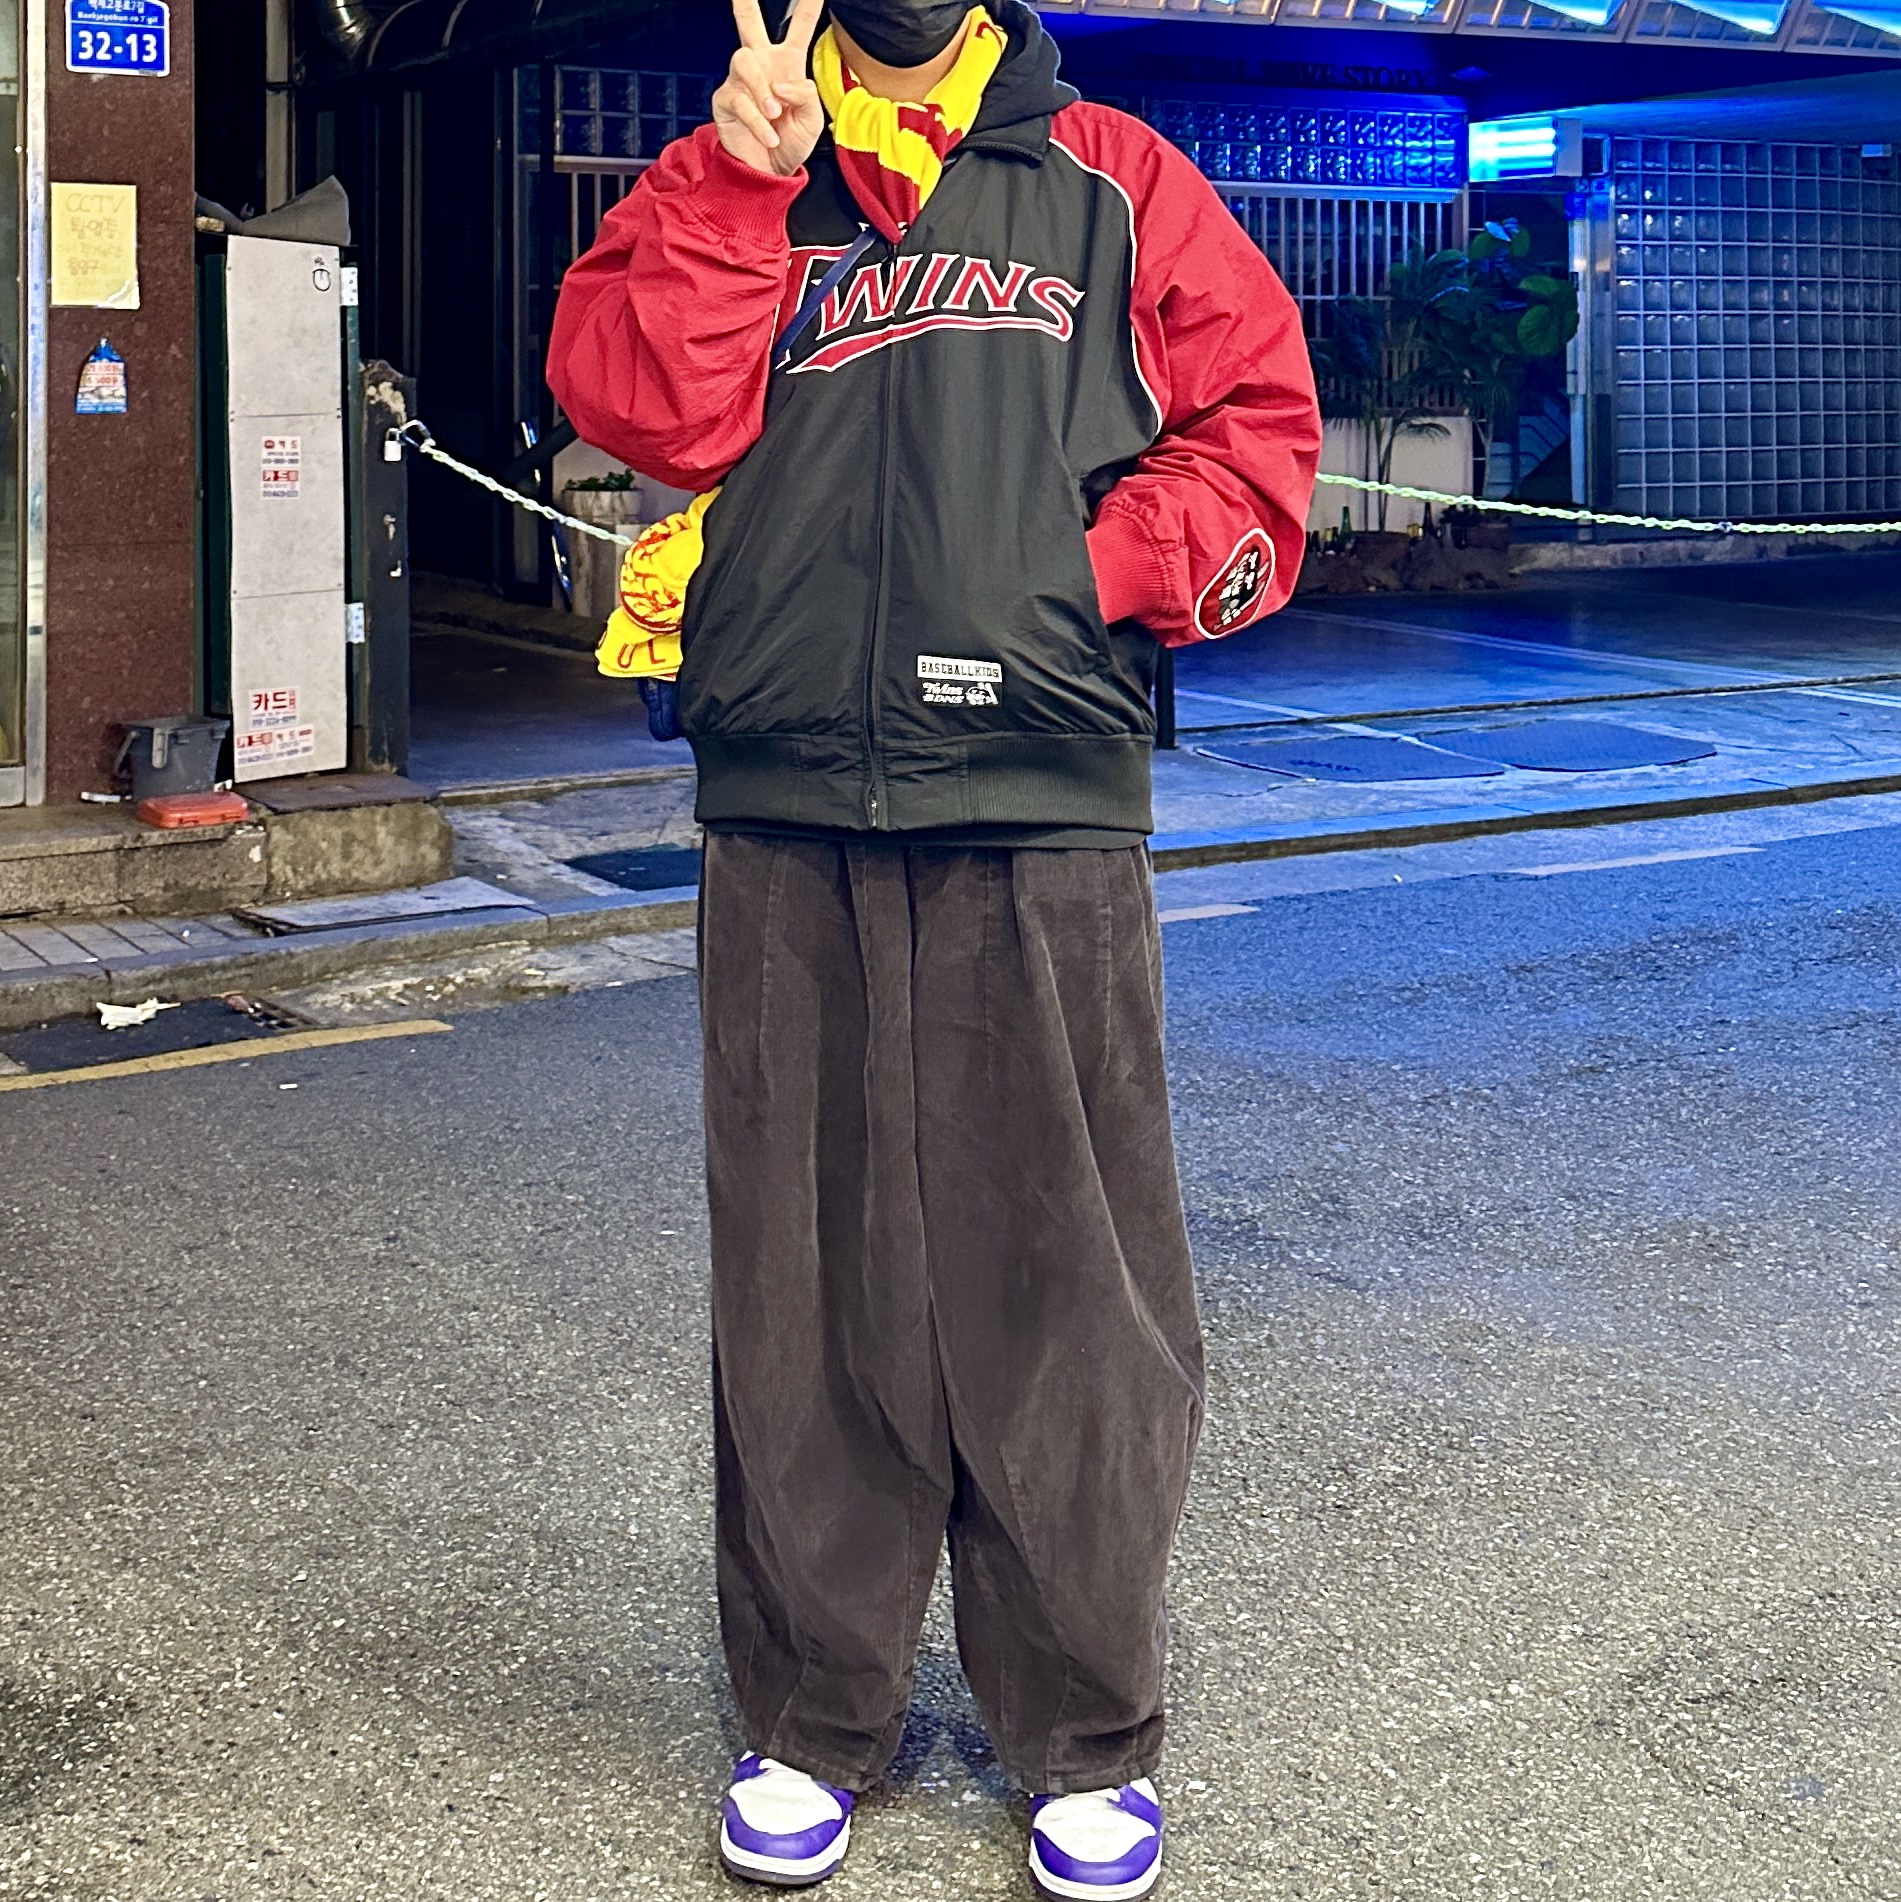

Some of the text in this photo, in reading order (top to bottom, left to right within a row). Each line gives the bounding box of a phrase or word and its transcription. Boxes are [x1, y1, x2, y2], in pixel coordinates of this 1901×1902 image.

[78, 30, 157, 62] 32-13
[1343, 63, 1432, 88] STORY
[65, 193, 126, 213] CCTV
[253, 691, 287, 711] 카드
